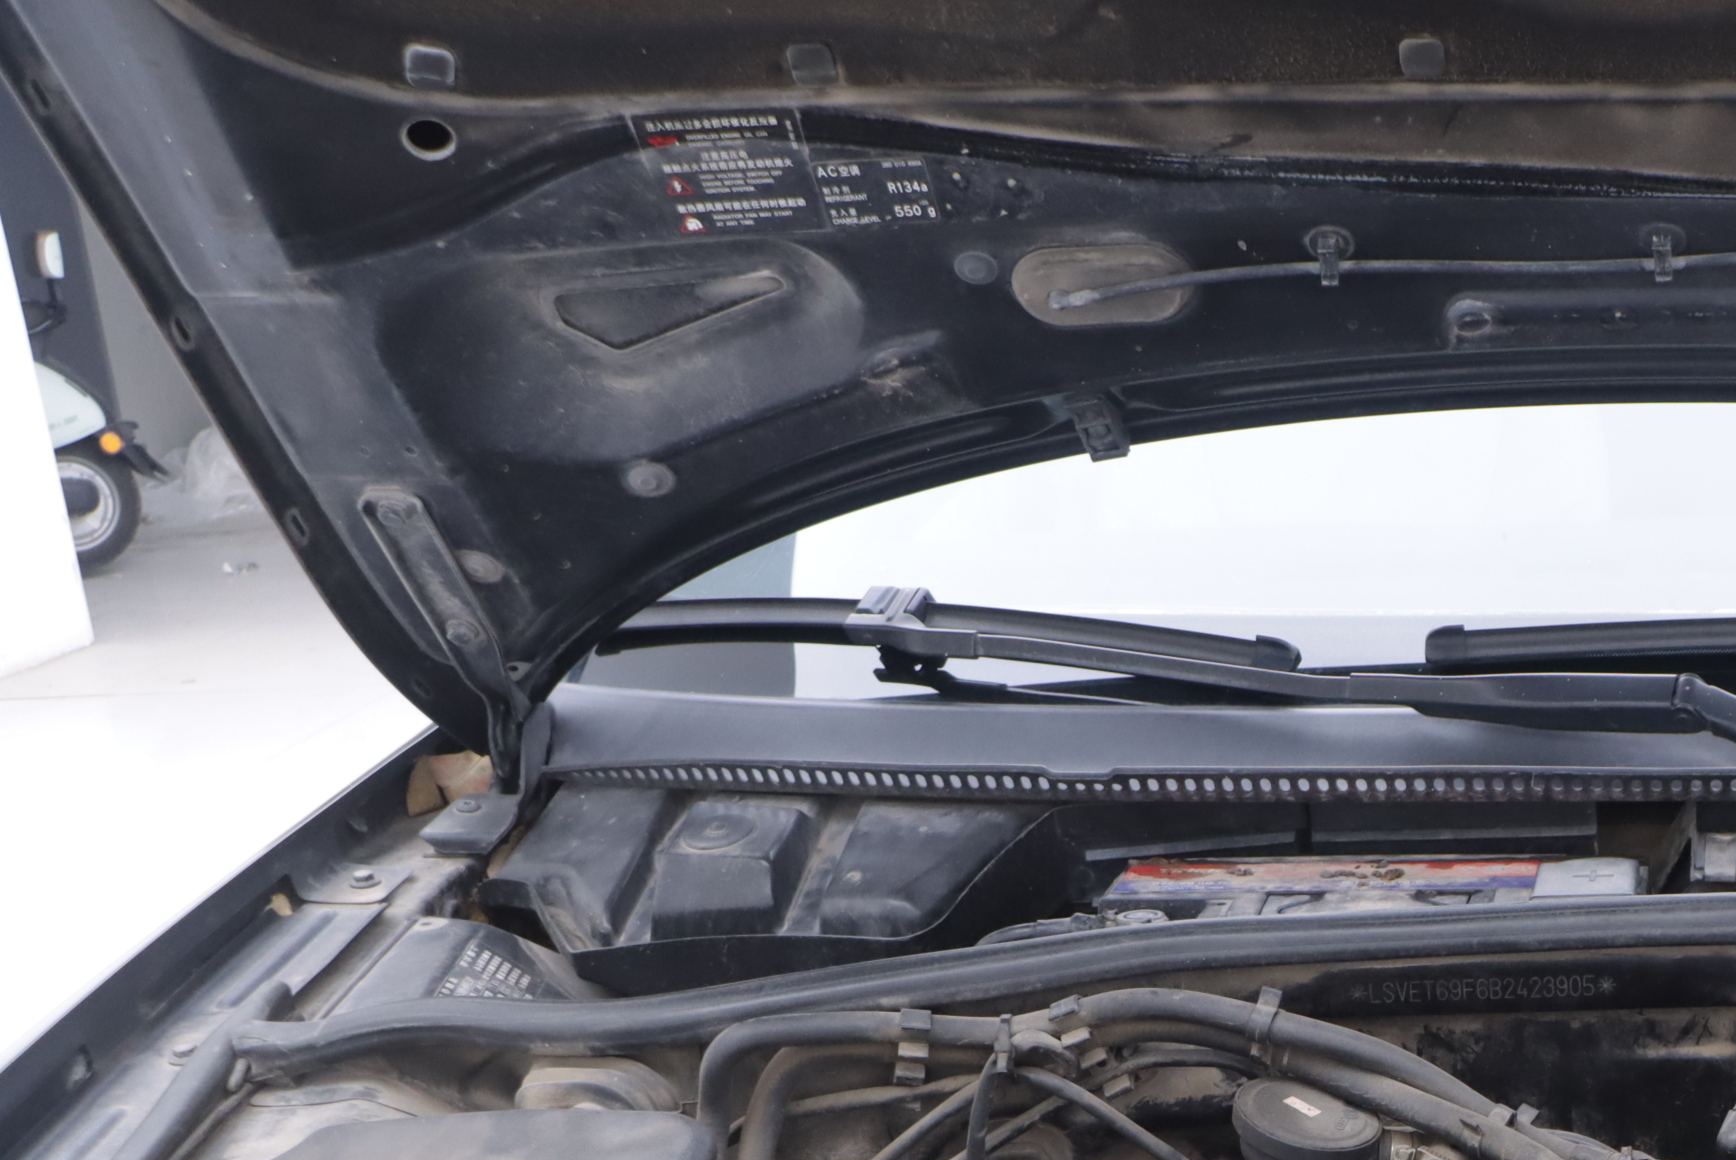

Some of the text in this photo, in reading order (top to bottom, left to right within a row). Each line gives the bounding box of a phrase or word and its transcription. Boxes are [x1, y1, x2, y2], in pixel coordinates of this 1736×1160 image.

[886, 180, 929, 194] R134a
[824, 193, 868, 203] REFRIGERANT
[759, 210, 772, 218] MAY
[773, 209, 793, 217] START
[893, 203, 937, 219] 550 g
[739, 218, 755, 226] TIME
[832, 216, 859, 226] CHARGE
